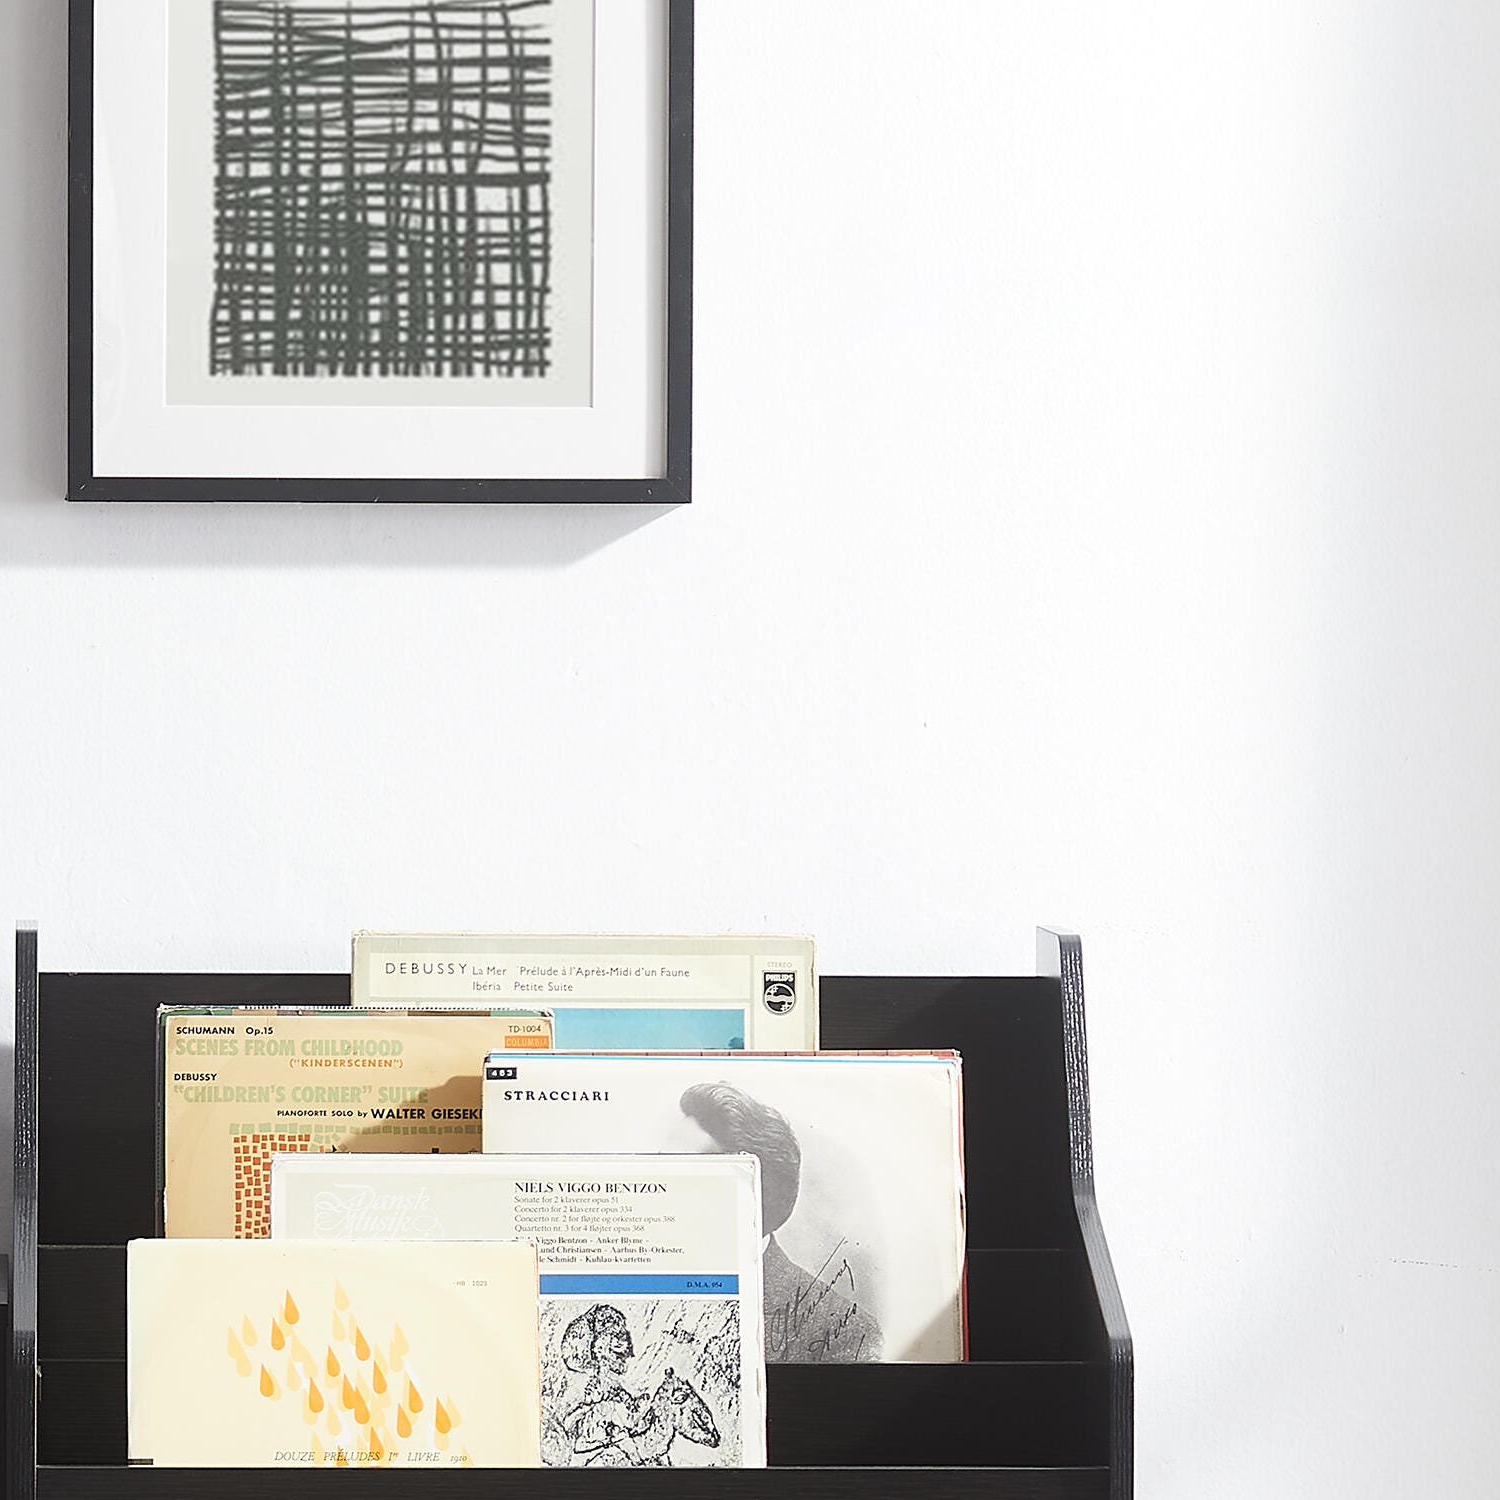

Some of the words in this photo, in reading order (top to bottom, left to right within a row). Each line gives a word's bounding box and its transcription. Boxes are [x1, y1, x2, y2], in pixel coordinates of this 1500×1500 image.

[386, 963, 467, 974] DEBUSSY
[472, 968, 483, 976] La
[487, 968, 507, 976] Mer
[635, 968, 657, 976] d'un
[660, 968, 690, 976] Faune
[473, 982, 501, 992] Ibéria
[514, 982, 544, 992] Petite
[548, 982, 573, 992] Suite
[176, 1027, 235, 1035] SCHUMANN
[246, 1027, 273, 1036] Op.15
[176, 1039, 238, 1056] SCENES
[245, 1039, 295, 1056] FROM
[301, 1039, 403, 1056] CHILDHOOD
[506, 1038, 548, 1047] COLUMBIA
[174, 1073, 217, 1081] DEBUSSY
[378, 1087, 428, 1103] SUITE
[504, 1091, 609, 1101] STRACCIARI
[358, 1110, 367, 1118] by
[371, 1109, 425, 1119] WALTER
[515, 1182, 554, 1193] NIELS
[558, 1182, 600, 1193] VIGGO
[606, 1182, 668, 1194] BENTZON
[592, 1197, 609, 1205] opus
[514, 1225, 551, 1233] Quartetto
[571, 1225, 581, 1233] for
[535, 1237, 556, 1245] Viggo
[539, 1246, 555, 1254] und
[557, 1246, 602, 1254] Christiansen
[275, 1451, 315, 1461] DOUZE
[324, 1448, 380, 1461] PRÉLUDES
[407, 1451, 440, 1461] LIVRE
[450, 1455, 467, 1463] 1910
